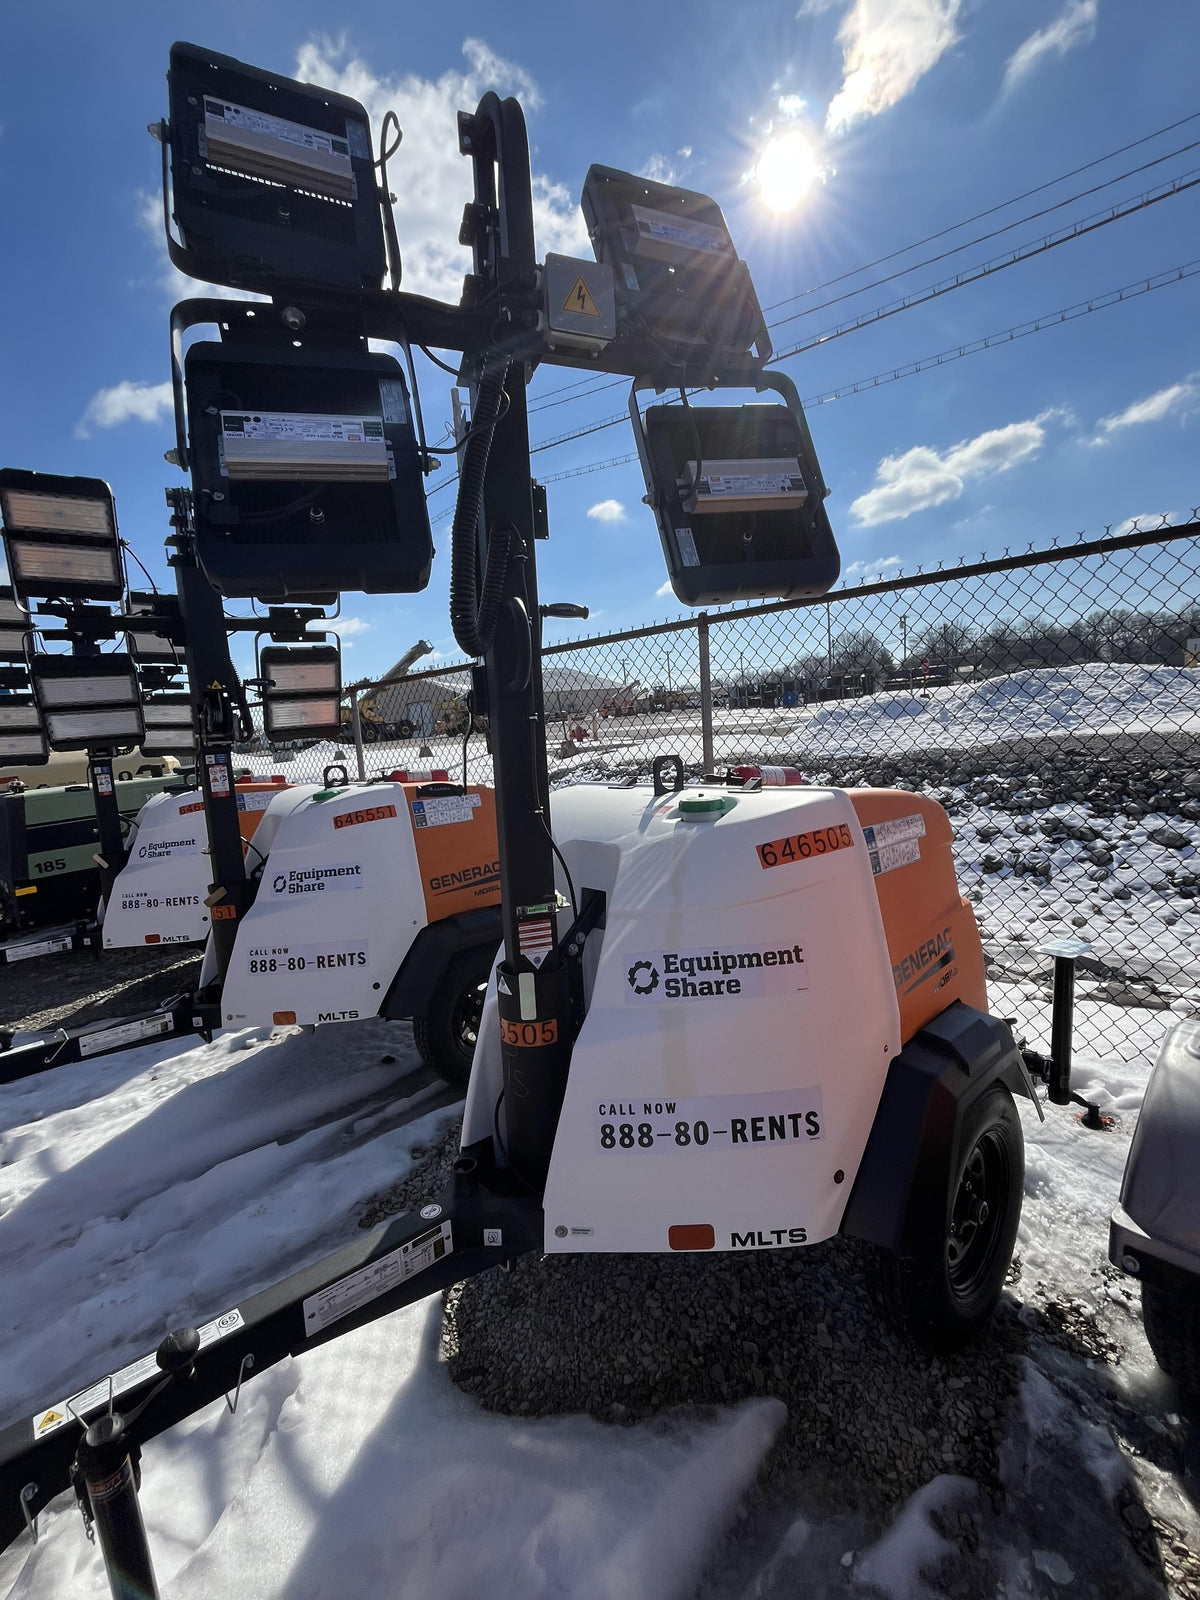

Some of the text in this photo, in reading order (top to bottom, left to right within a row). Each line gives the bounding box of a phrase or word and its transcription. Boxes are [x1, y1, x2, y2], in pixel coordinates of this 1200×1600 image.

[334, 807, 395, 828] 646551
[148, 838, 196, 851] Equipment
[760, 824, 854, 867] 646505
[147, 849, 172, 859] Share
[35, 858, 67, 875] 185
[288, 864, 361, 883] Equipment
[288, 881, 325, 894] Share
[474, 885, 501, 897] MOBIL
[121, 896, 199, 910] 888-80-RENTS
[212, 906, 232, 919] 51
[163, 935, 190, 943] MLTS
[249, 947, 289, 957] CALL NOW
[892, 926, 952, 988] GENERAC
[250, 951, 367, 973] 888-80-RENTS
[662, 945, 804, 976] Equipment
[664, 978, 742, 998] Share
[318, 1010, 359, 1022] MLTS
[598, 1102, 677, 1116] CALL NOW
[600, 1110, 821, 1149] 888-80-RENTS
[731, 1227, 807, 1248] MLTS
